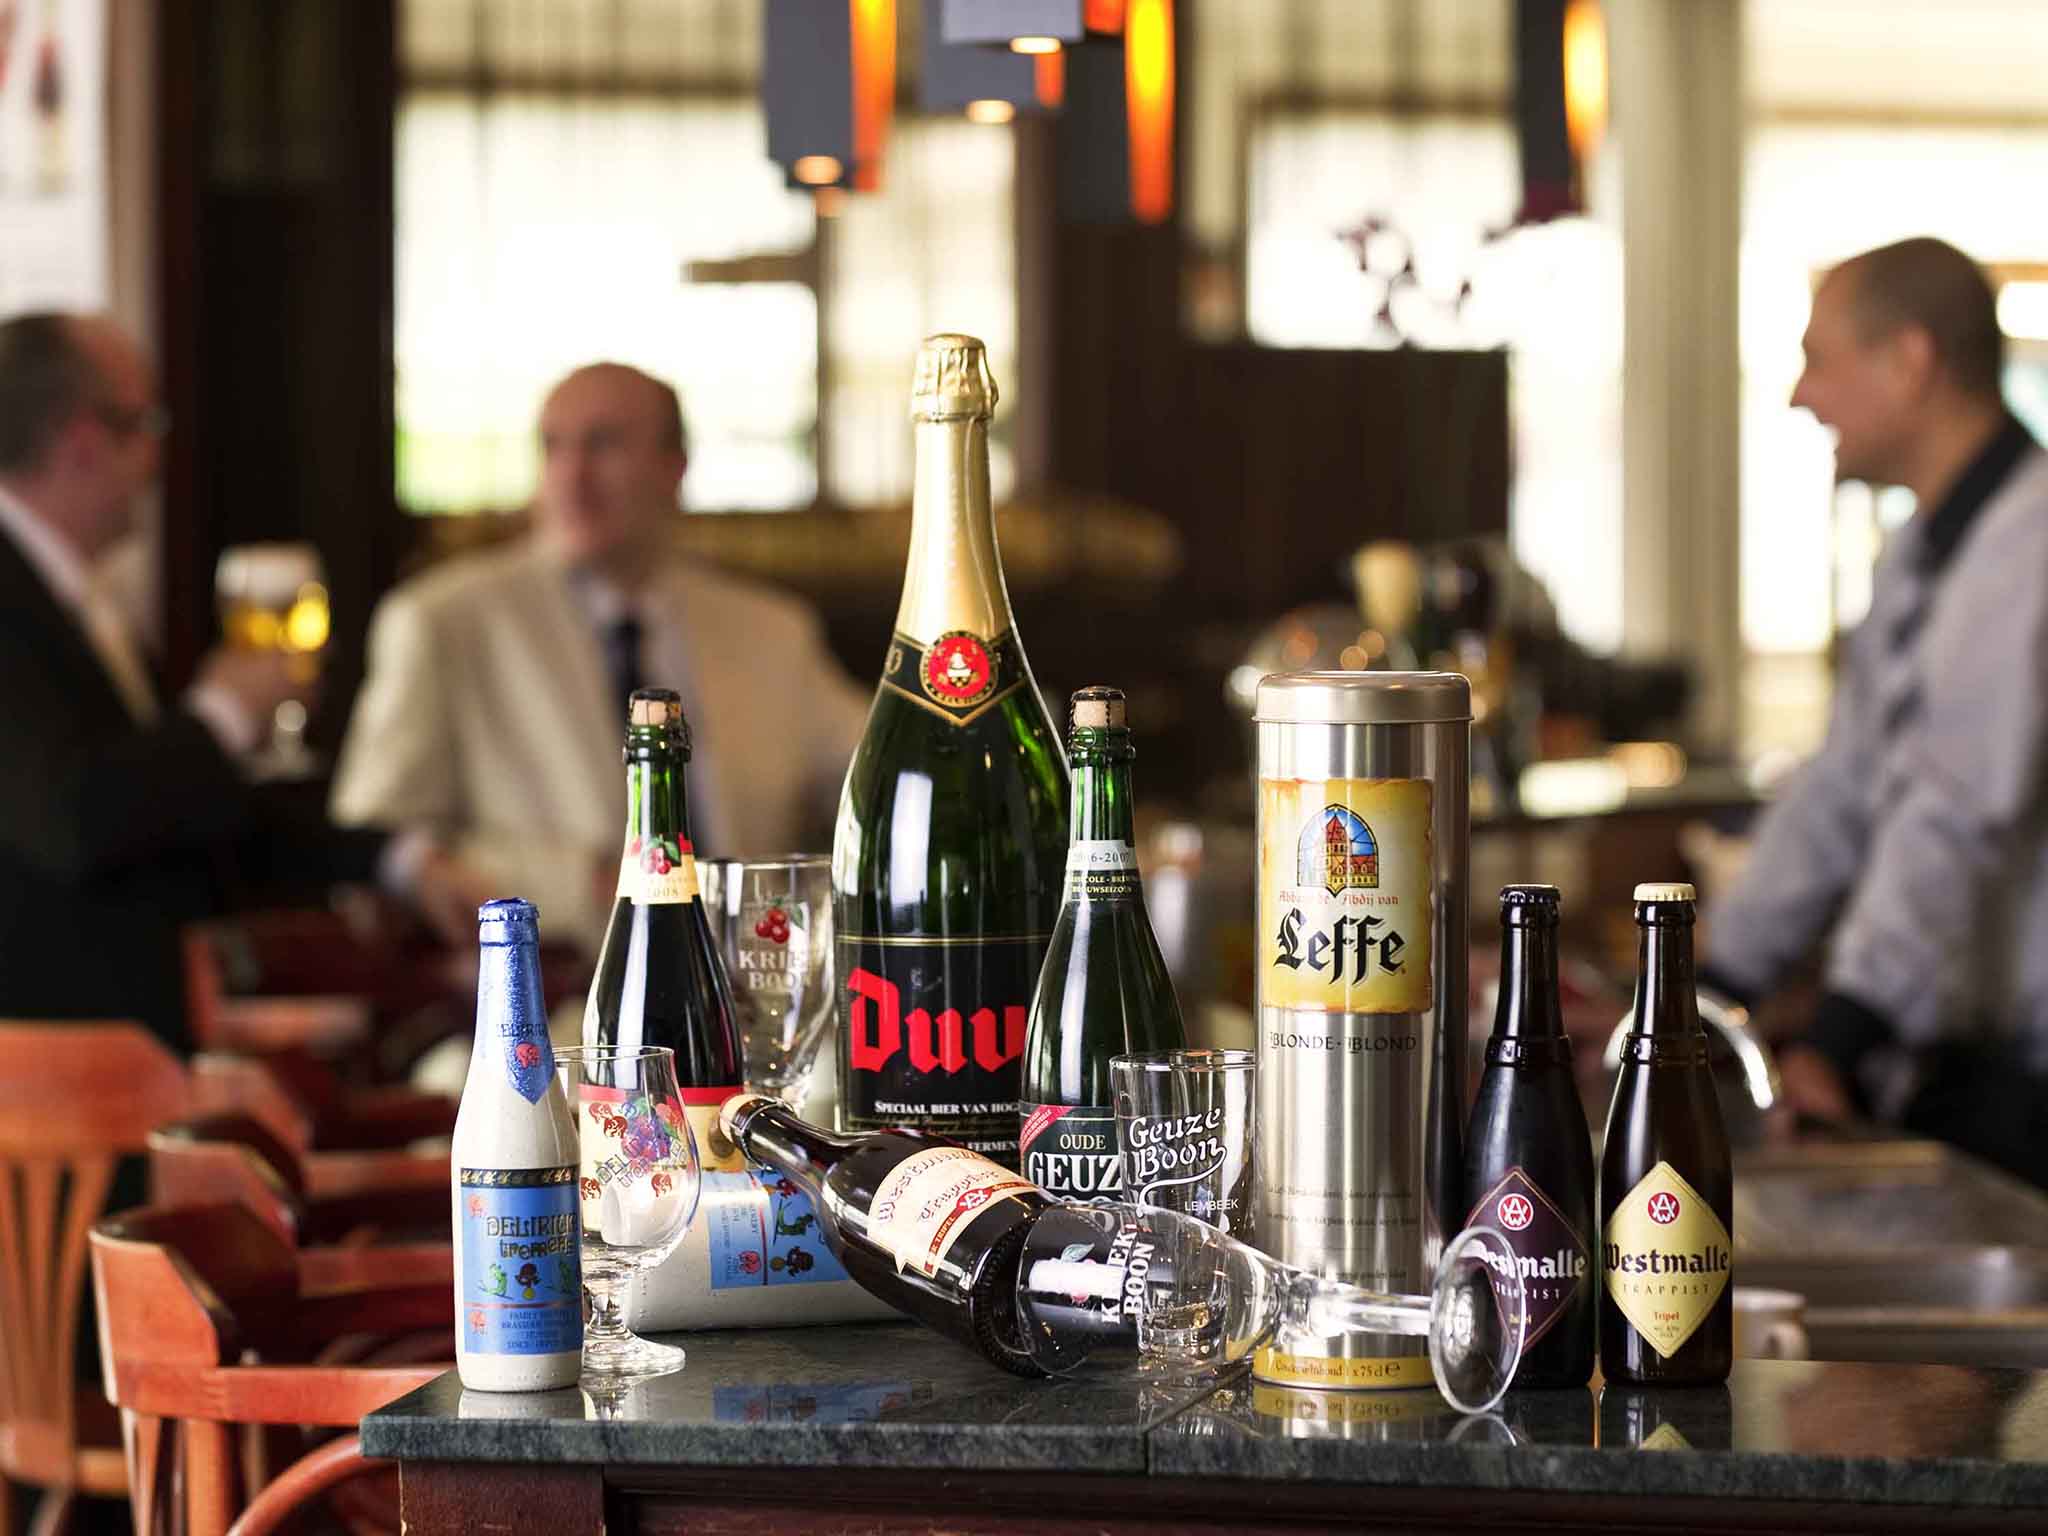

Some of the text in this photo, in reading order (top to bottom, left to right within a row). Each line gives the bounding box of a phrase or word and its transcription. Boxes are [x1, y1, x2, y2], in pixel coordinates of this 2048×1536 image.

[1378, 895, 1399, 905] van
[1273, 906, 1406, 986] Leffe
[874, 1100, 927, 1115] SPECIAAL
[931, 1101, 960, 1115] BIER
[962, 1102, 988, 1114] VAN
[1129, 1107, 1221, 1148] Geuze
[1060, 1133, 1106, 1150] OUDE
[1138, 1137, 1227, 1178] Boon
[1604, 1243, 1729, 1274] Westmalle
[1123, 1241, 1155, 1315] BOON
[1623, 1283, 1710, 1296] TRAPPIST
[1653, 1311, 1681, 1323] Tripel
